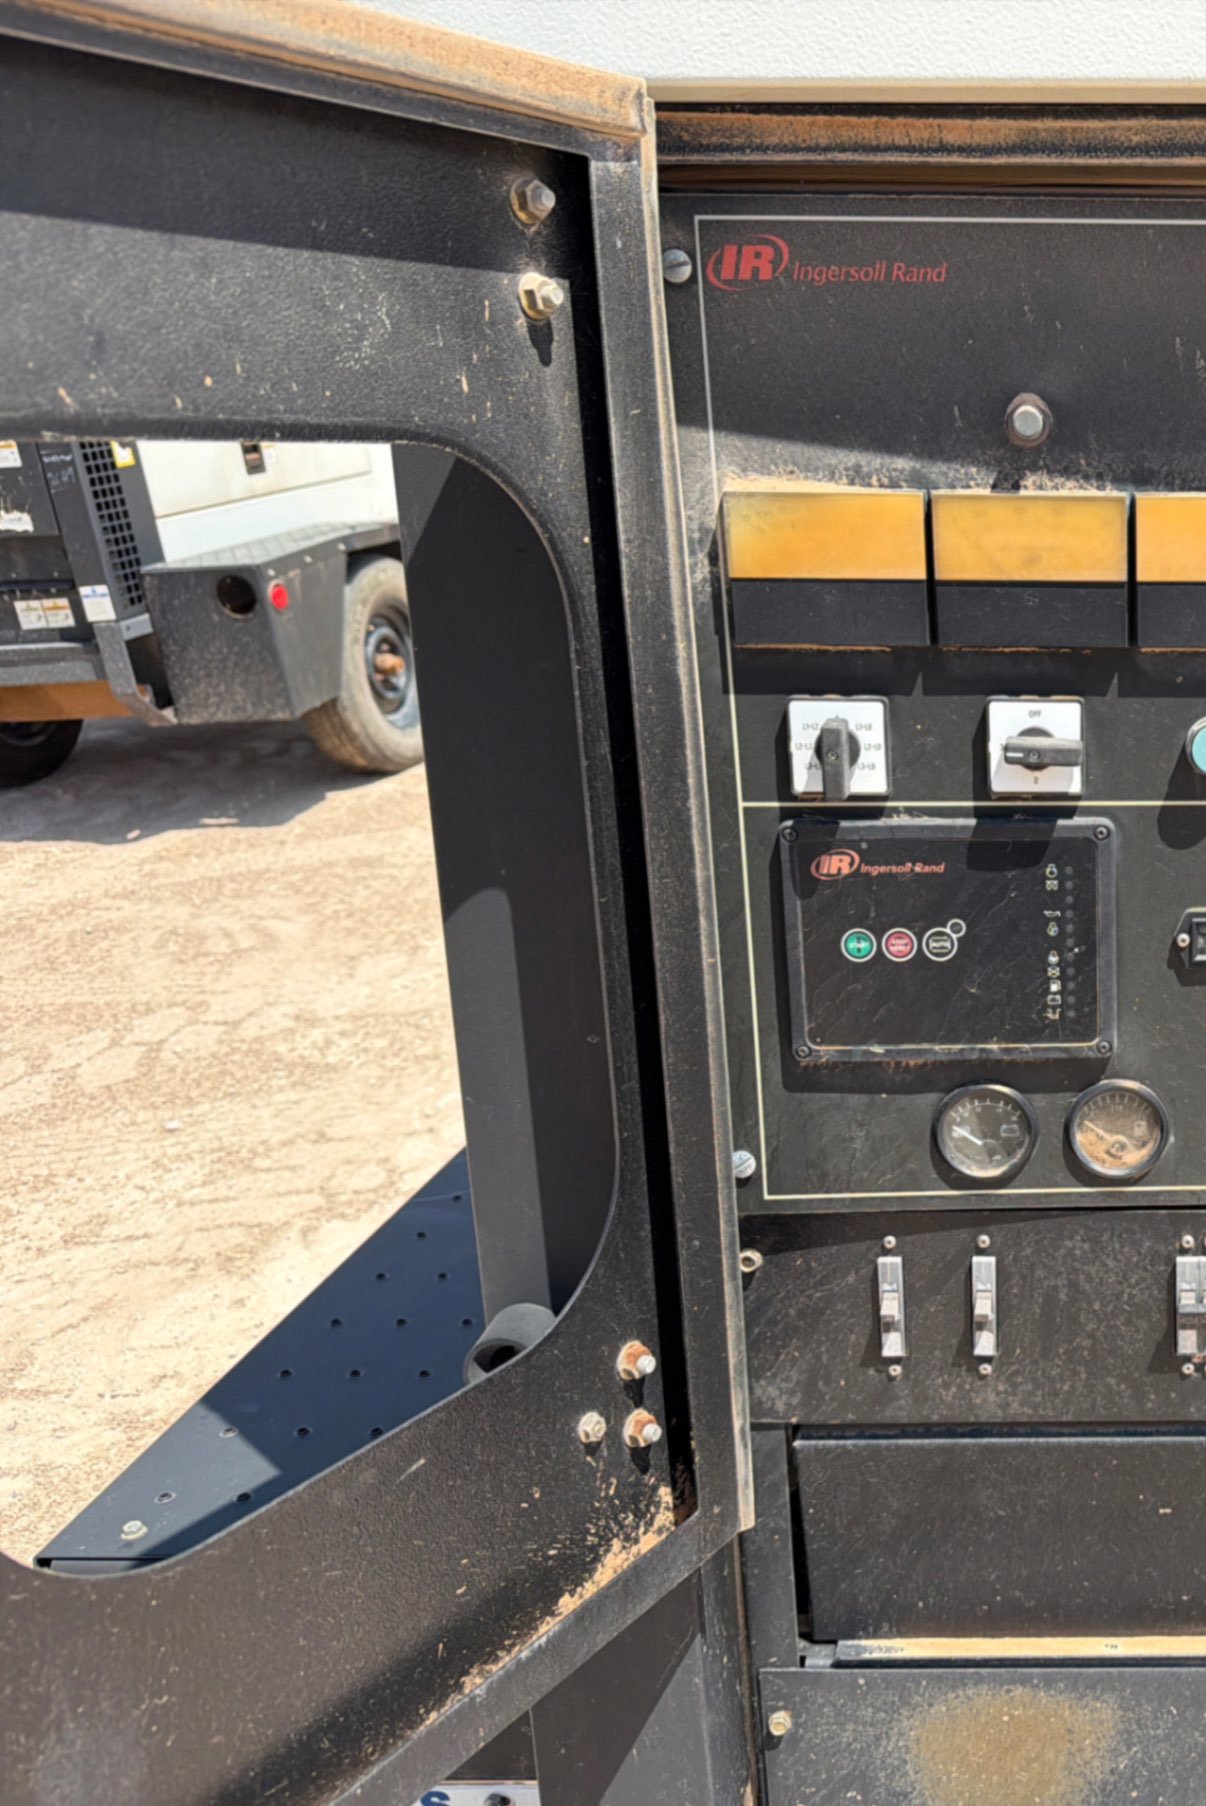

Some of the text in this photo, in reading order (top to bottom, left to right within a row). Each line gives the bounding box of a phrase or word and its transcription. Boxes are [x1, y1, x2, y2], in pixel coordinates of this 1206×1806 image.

[793, 261, 947, 285] Ingersoll Rand
[1029, 710, 1041, 718] OFF
[860, 862, 944, 876] Ingersoll Rand
